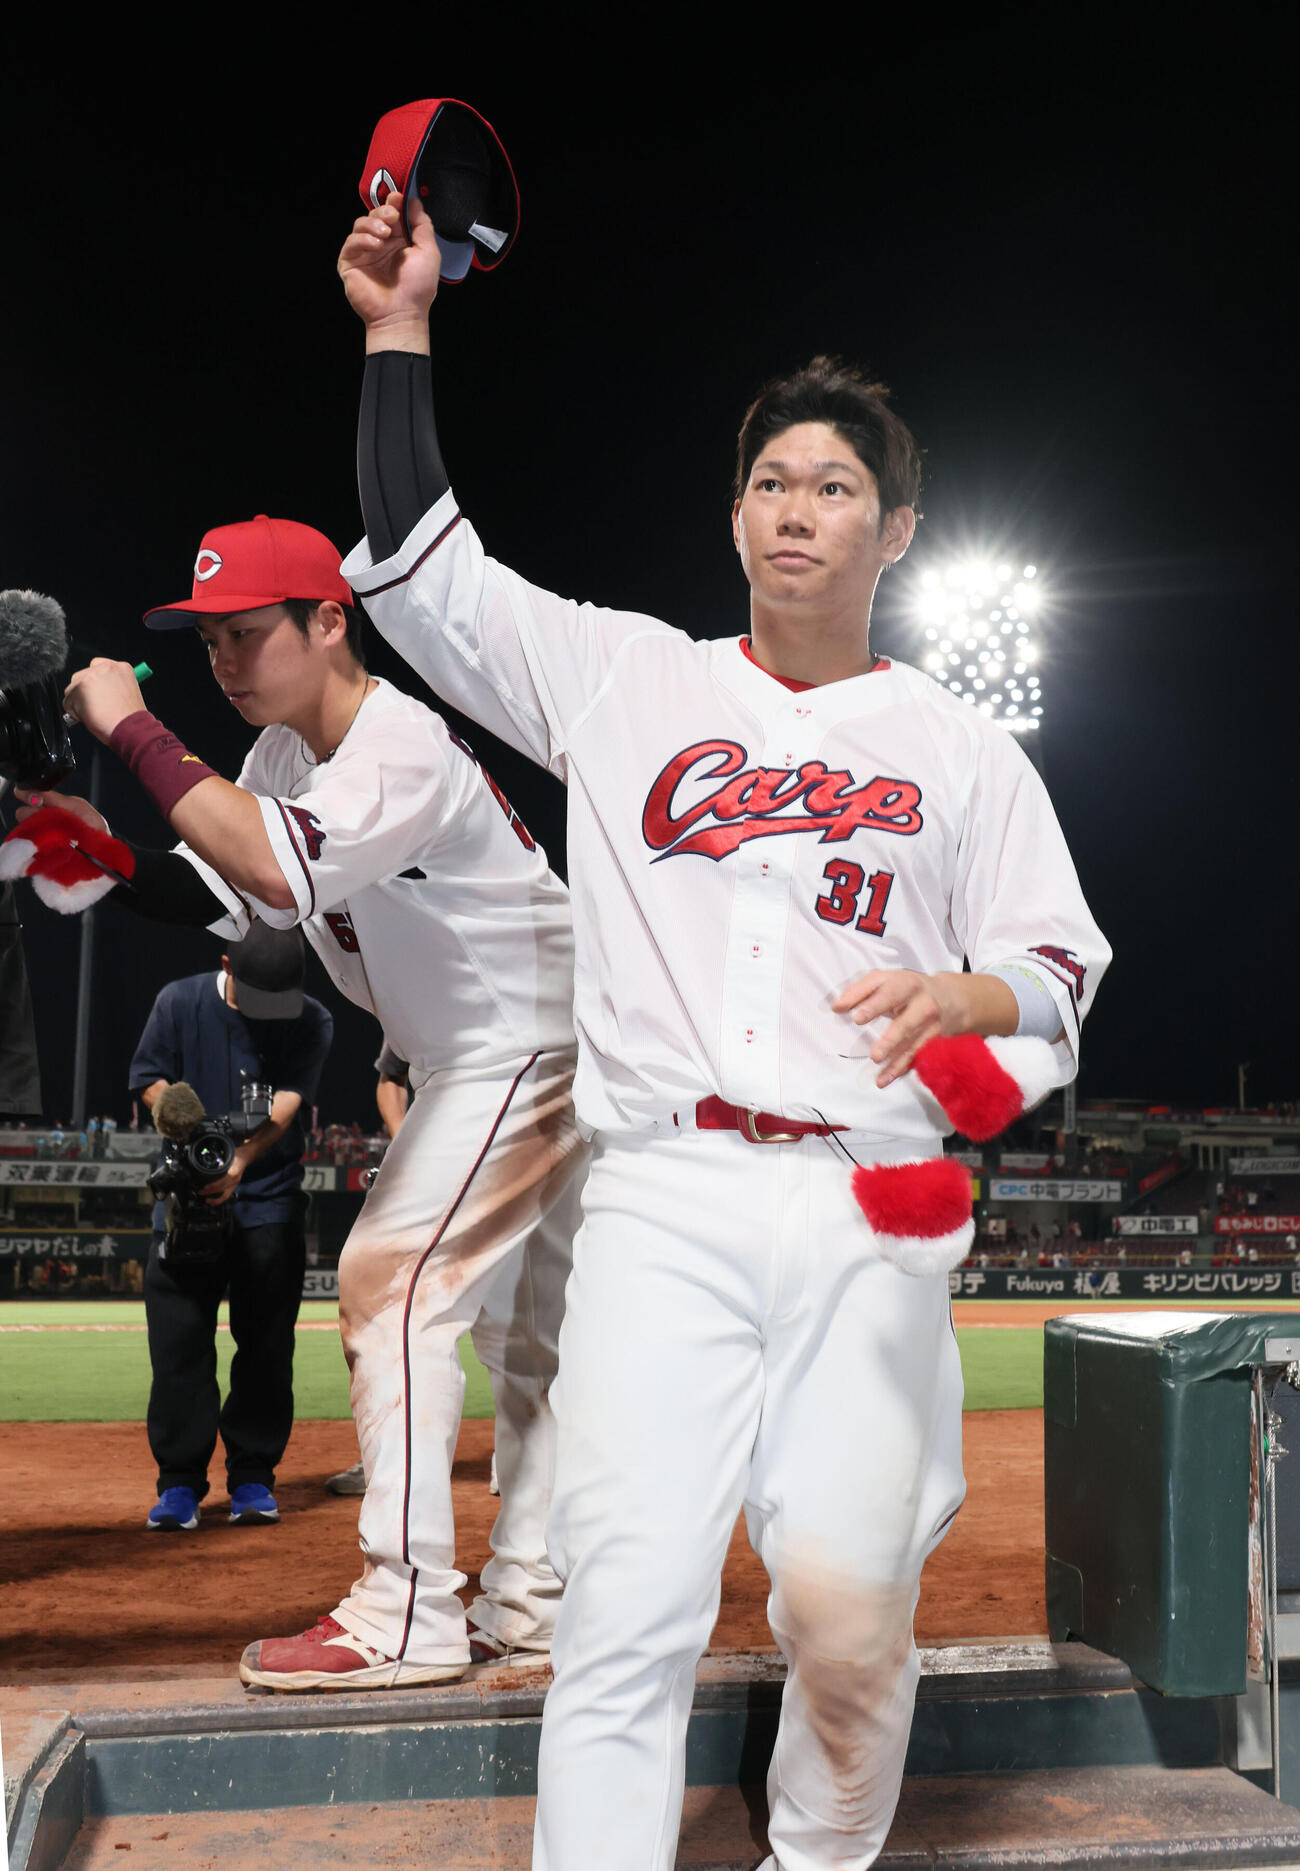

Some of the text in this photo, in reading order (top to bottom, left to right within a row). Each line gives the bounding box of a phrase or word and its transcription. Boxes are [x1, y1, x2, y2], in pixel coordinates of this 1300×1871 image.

[194, 548, 223, 582] C
[642, 739, 923, 864] Carp
[815, 858, 895, 937] 31
[999, 1183, 1119, 1199] CPC 中電プラント
[1141, 1218, 1193, 1232] 中電工
[1006, 1275, 1064, 1293] Fukuya
[1143, 1273, 1282, 1293] キリンビバレッジ
